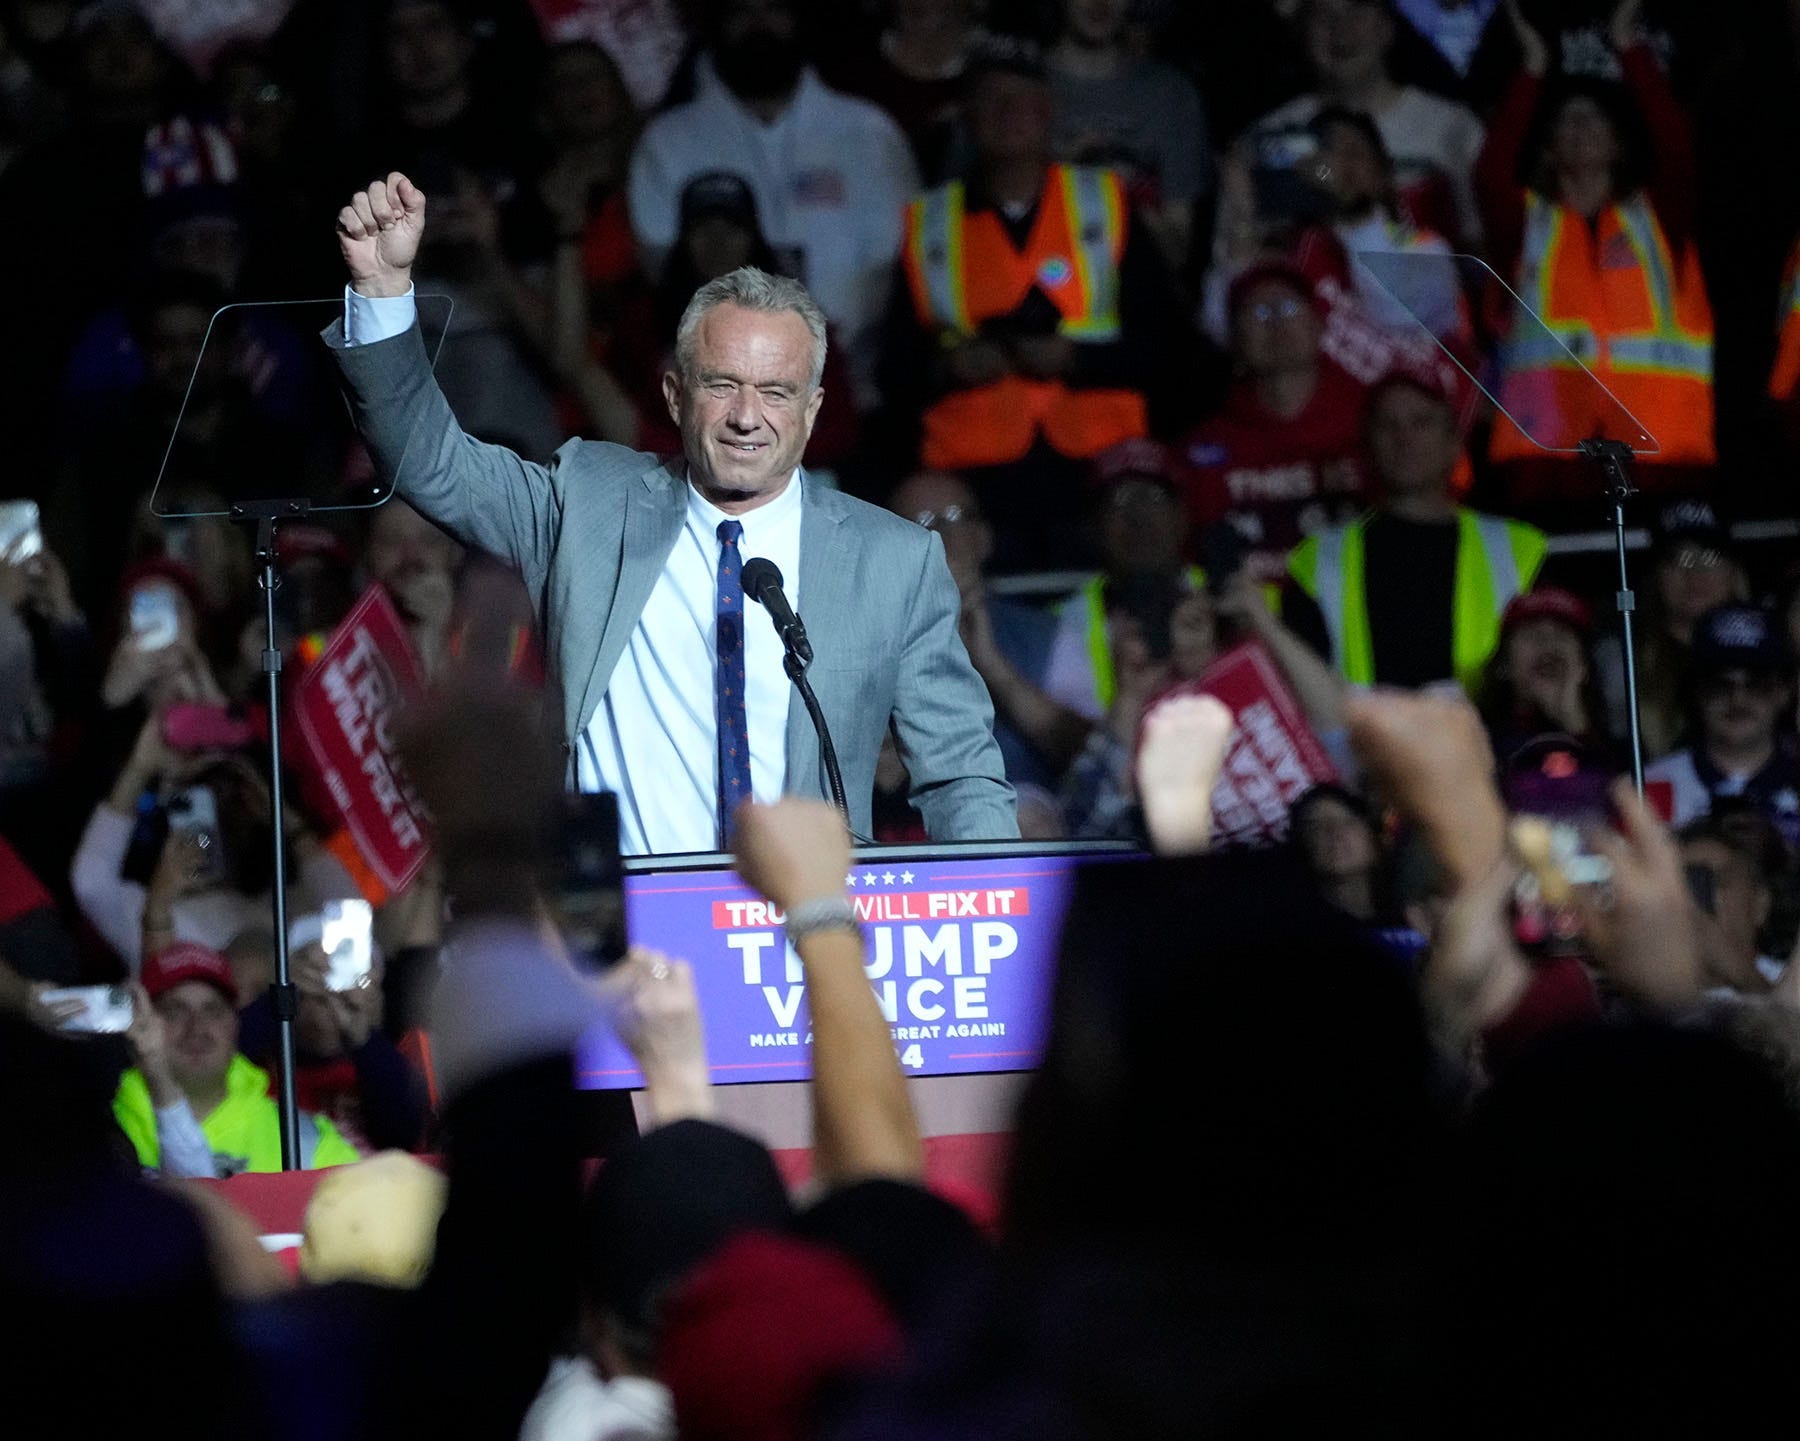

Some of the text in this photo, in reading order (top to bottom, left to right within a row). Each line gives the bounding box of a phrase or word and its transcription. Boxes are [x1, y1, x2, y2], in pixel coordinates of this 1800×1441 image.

[321, 659, 373, 756] WILL
[361, 748, 422, 850] FIX IT
[725, 900, 788, 927] TRU
[928, 891, 980, 918] FIX
[986, 889, 1016, 915] IT
[762, 976, 989, 1028] VNCE
[749, 1032, 799, 1047] MAKE
[946, 1022, 1006, 1038] AGAIN!
